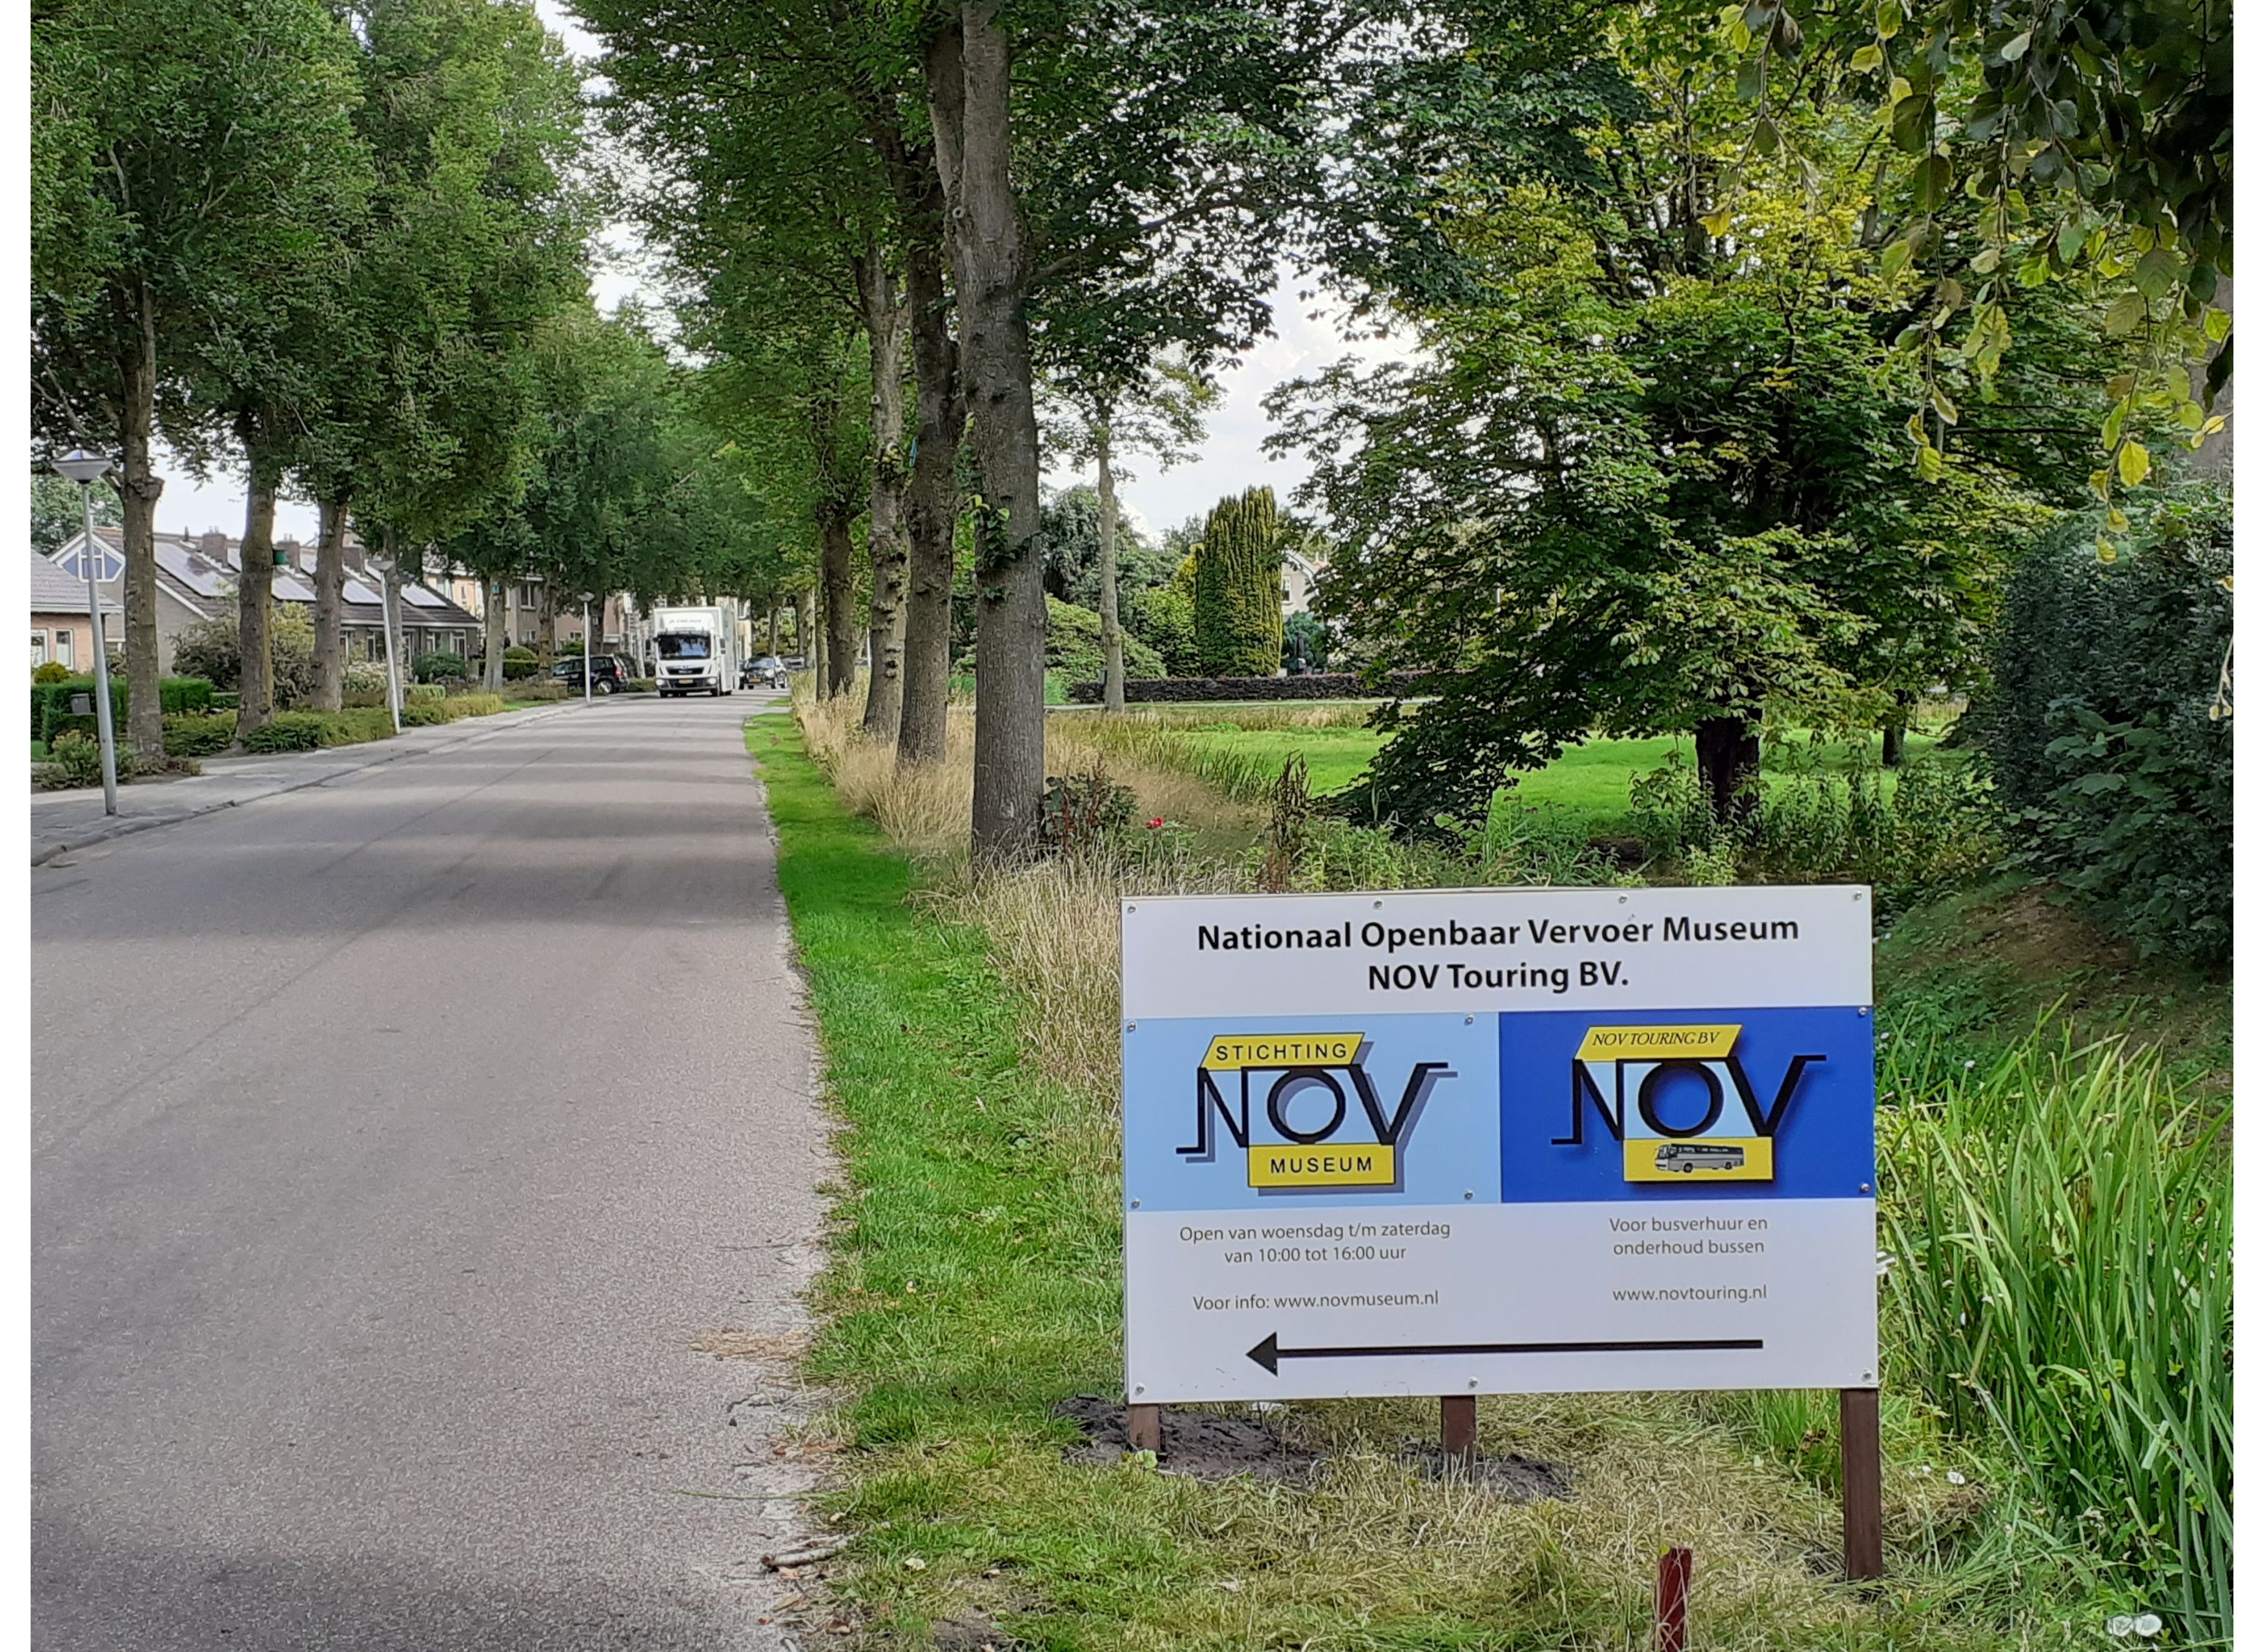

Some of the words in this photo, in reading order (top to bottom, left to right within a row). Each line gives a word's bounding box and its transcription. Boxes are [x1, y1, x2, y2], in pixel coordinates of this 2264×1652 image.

[1198, 922, 1351, 950] Nationaal
[1361, 920, 1521, 954] Openbaar
[1528, 919, 1653, 943] Vervoer
[1663, 917, 1798, 942] Museum
[1369, 964, 1440, 990] NOV
[1447, 962, 1569, 994] Touring
[1580, 961, 1628, 986] BV.
[1592, 1033, 1627, 1046] NOV
[1630, 1032, 1696, 1045] TOURING
[1697, 1031, 1721, 1044] BV
[1216, 1043, 1347, 1061] STICHTING
[1176, 1062, 1448, 1154] NOV
[1551, 1054, 1826, 1145] NOV
[1270, 1156, 1372, 1174] MUSEUM
[1180, 1226, 1224, 1244] Open
[1228, 1229, 1257, 1240] van
[1262, 1222, 1344, 1241] woensdag
[1349, 1222, 1376, 1238] t/m
[1381, 1220, 1450, 1238] zaterdag
[1609, 1218, 1647, 1232] Voor
[1651, 1216, 1743, 1232] busverhuur
[1747, 1218, 1768, 1230] en
[1224, 1252, 1253, 1263] van
[1259, 1247, 1301, 1262] 10:00
[1305, 1248, 1328, 1262] tot
[1333, 1246, 1375, 1260] 16:00
[1379, 1248, 1407, 1260] uur
[1613, 1239, 1704, 1256] onderhoud
[1708, 1239, 1765, 1254] bussen
[1193, 1296, 1231, 1311] Voor
[1235, 1293, 1270, 1310] info:
[1273, 1290, 1439, 1308] www.novmuseum.nl
[1612, 1284, 1767, 1303] www.novtouring.nl
